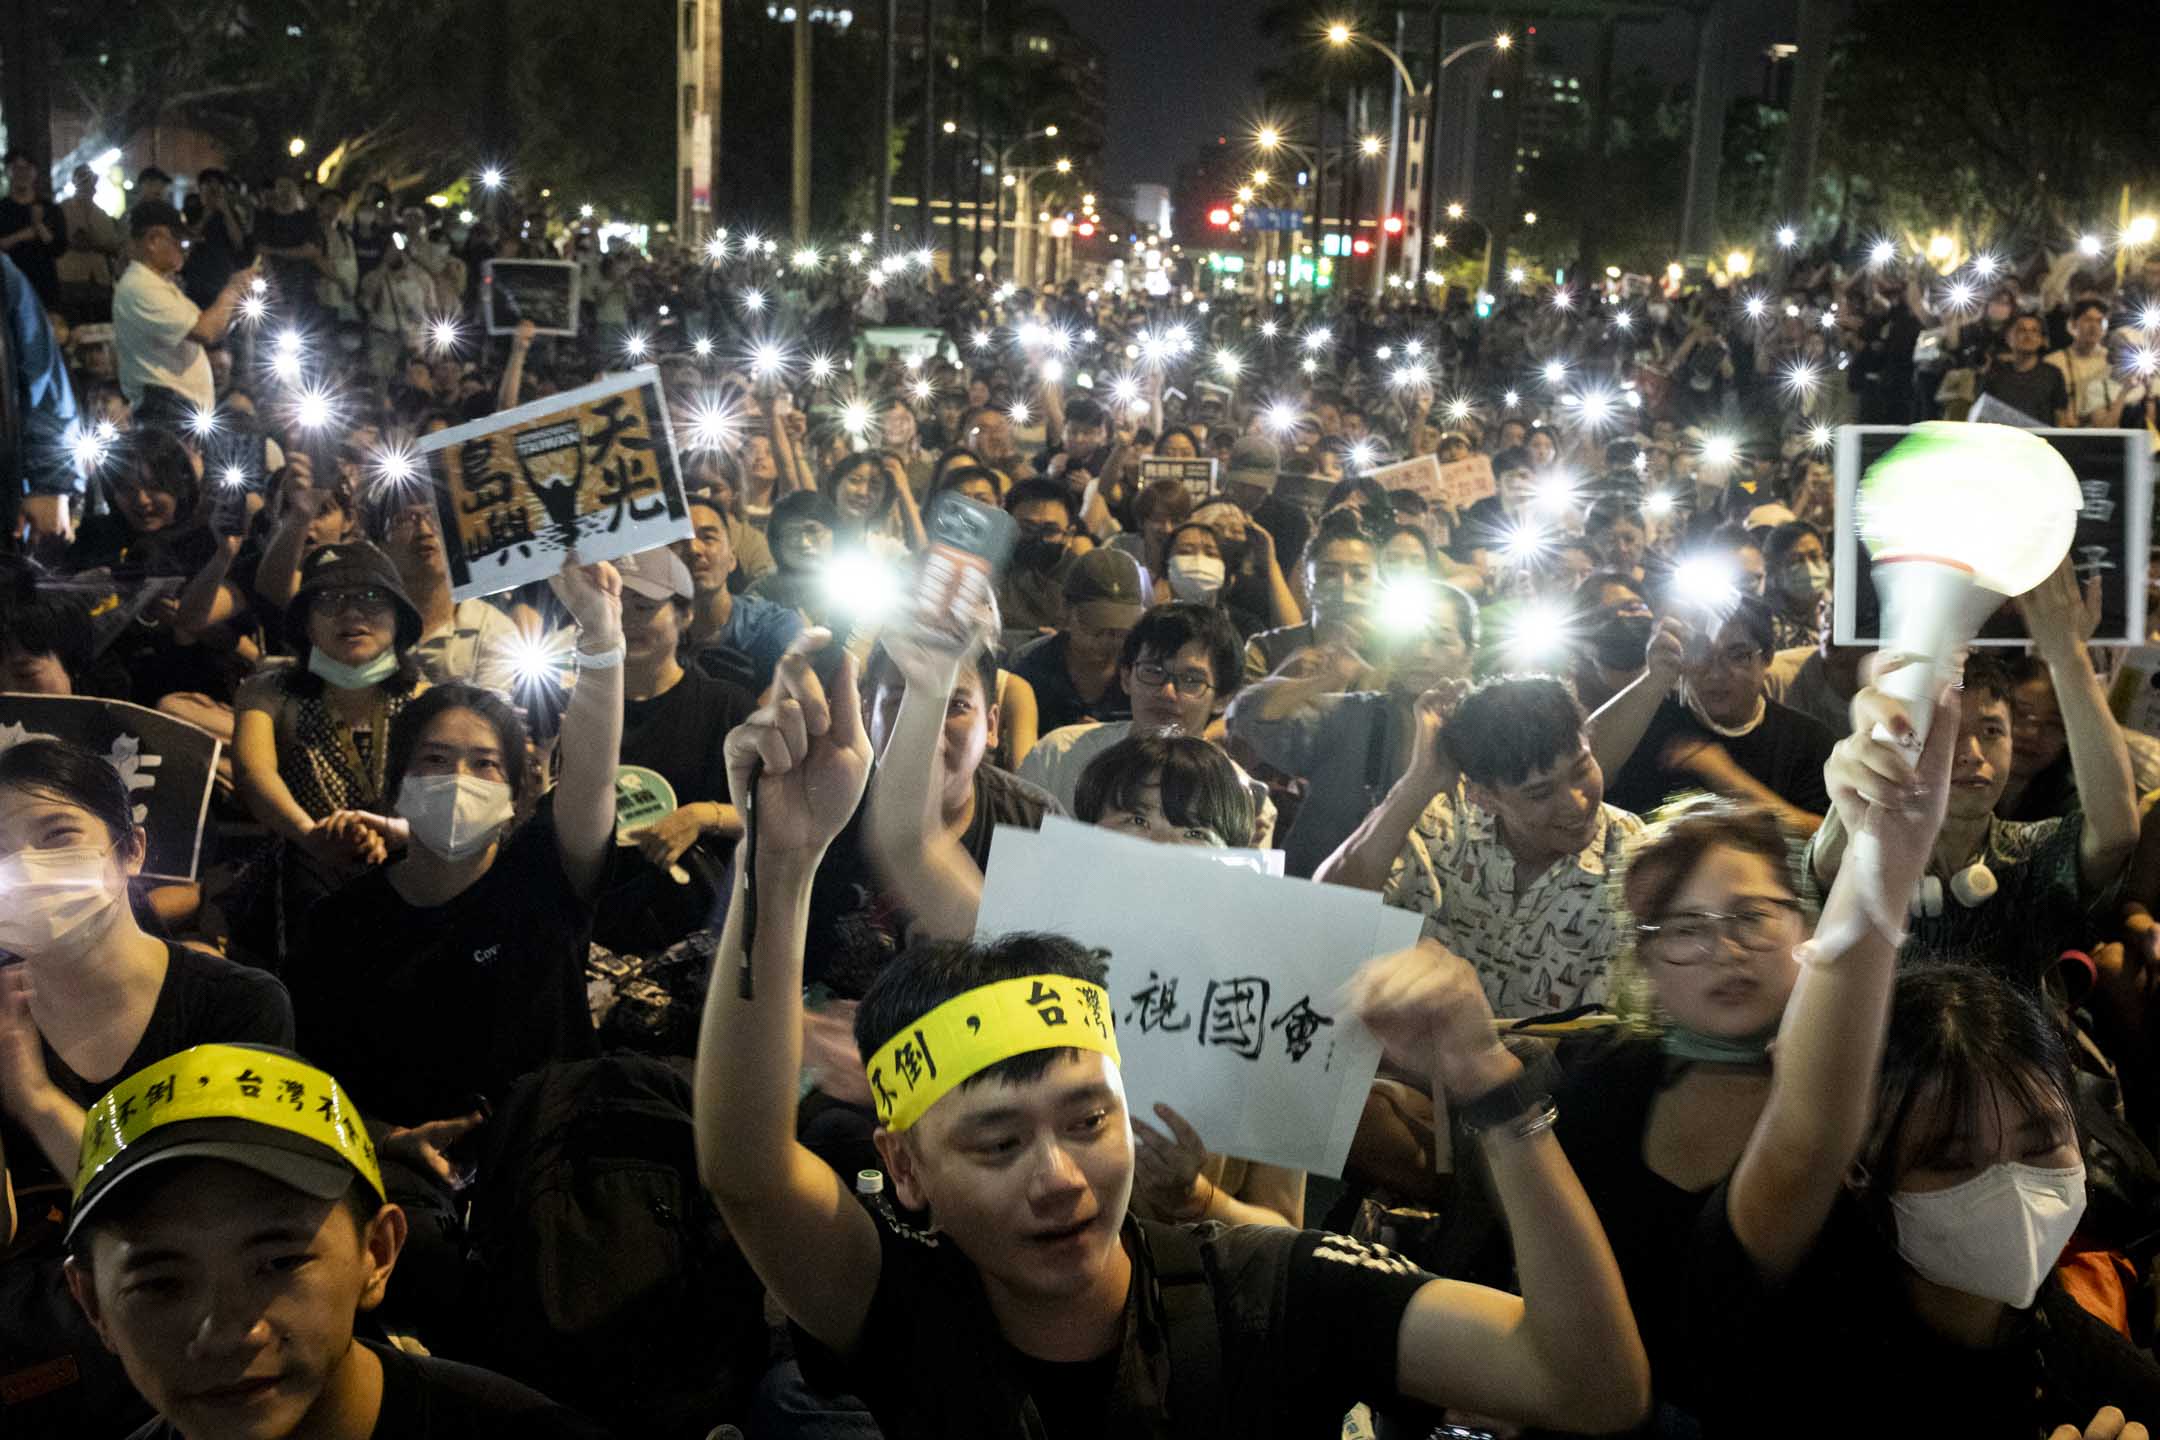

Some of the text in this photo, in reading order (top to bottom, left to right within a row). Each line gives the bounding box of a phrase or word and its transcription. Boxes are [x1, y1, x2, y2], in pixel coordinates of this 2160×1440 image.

[584, 396, 667, 533] 天光
[1111, 970, 1335, 1063] 視國會
